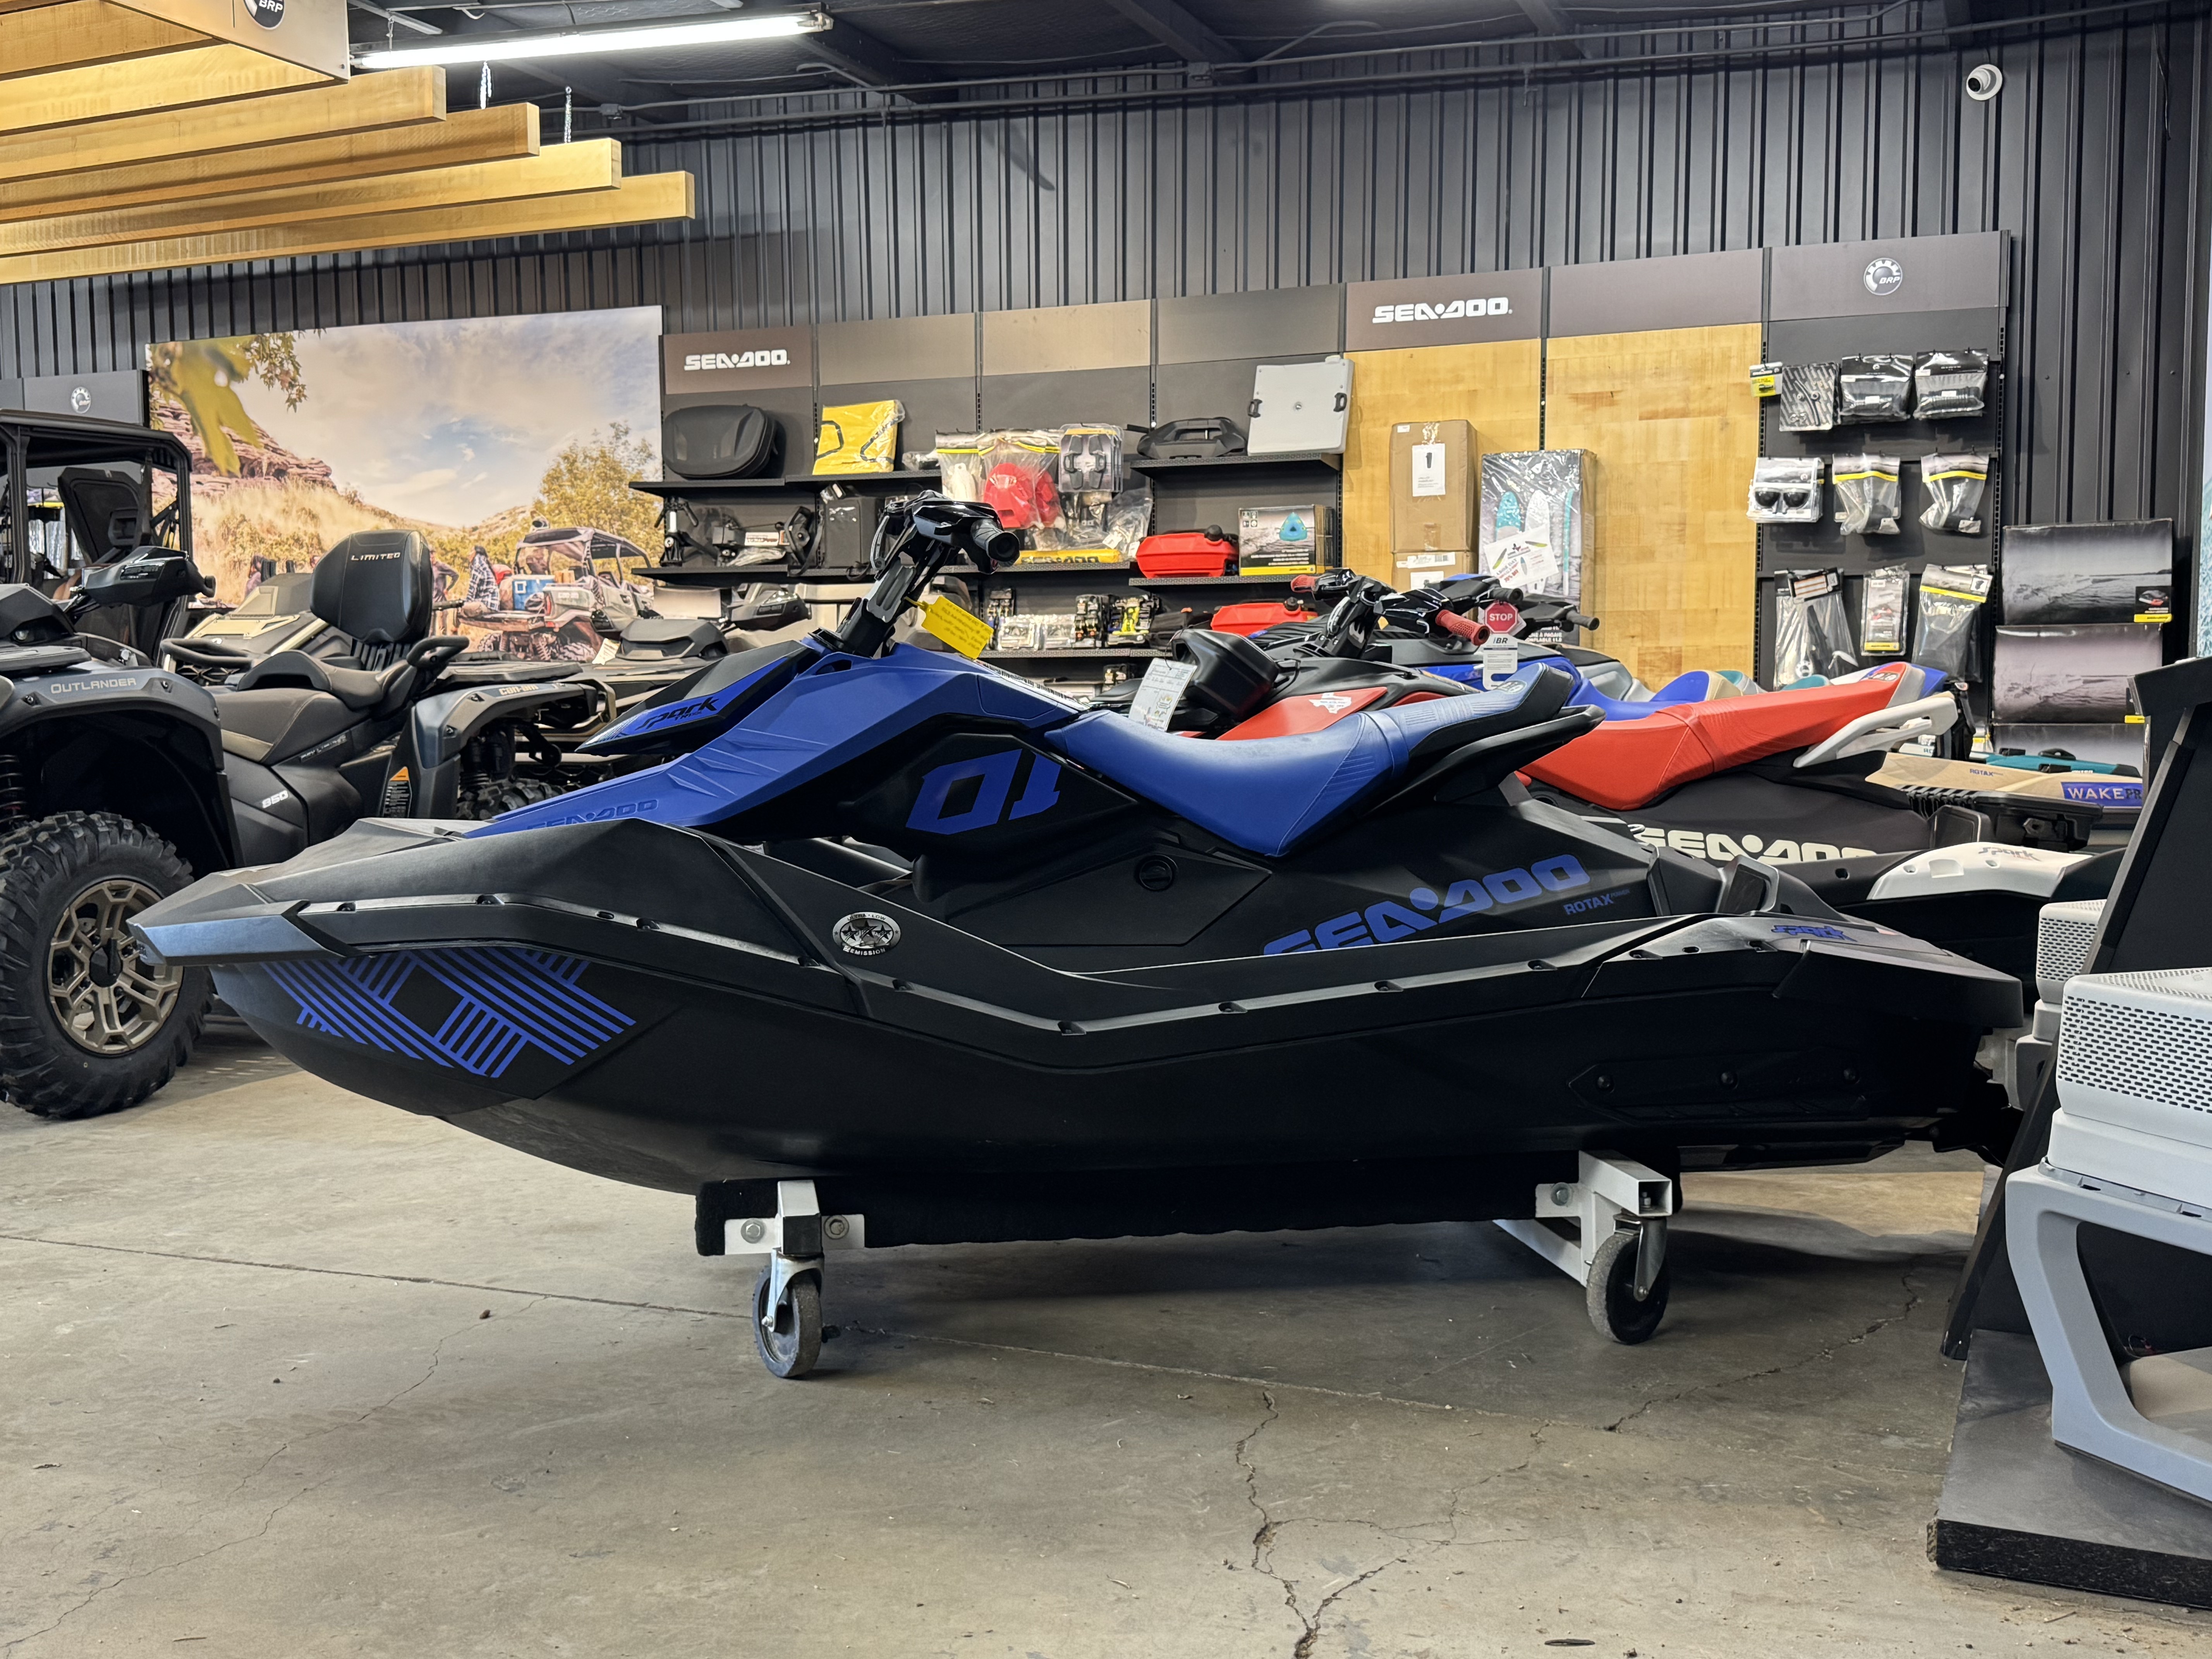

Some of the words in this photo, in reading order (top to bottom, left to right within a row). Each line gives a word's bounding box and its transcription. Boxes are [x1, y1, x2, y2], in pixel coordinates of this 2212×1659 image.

[259, 0, 283, 12] BRP
[351, 552, 400, 561] LIMITED
[51, 678, 136, 694] OUTLANDER
[262, 790, 288, 809] 850
[2068, 788, 2142, 799] WAKEPR
[1563, 893, 1614, 915] ROTAX
